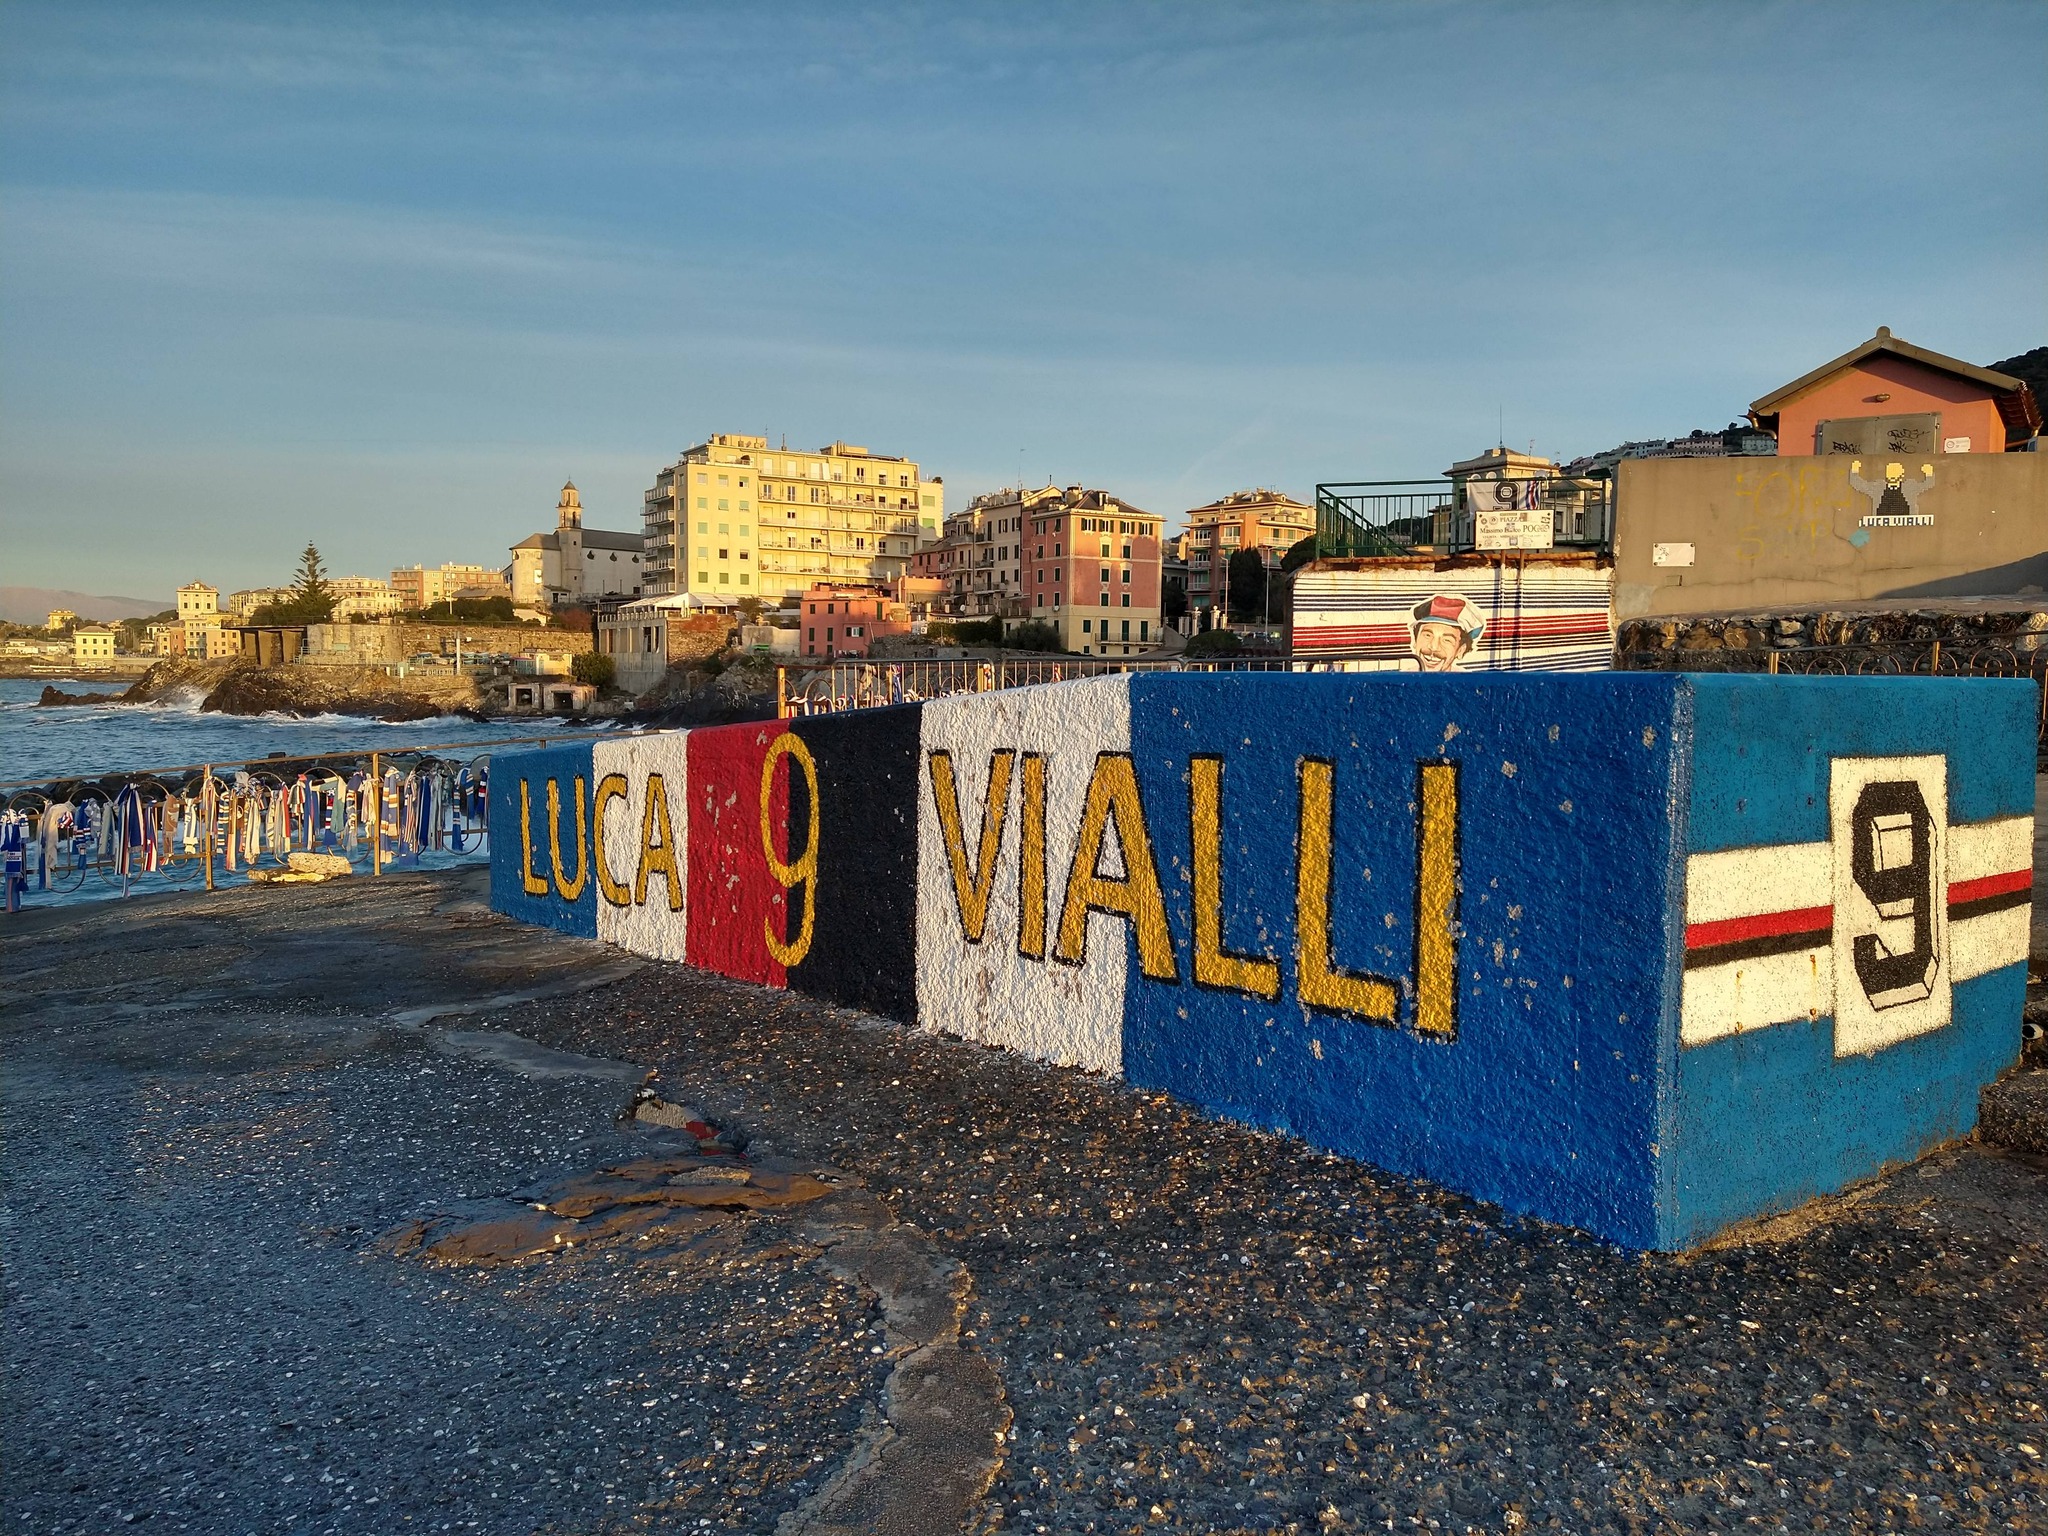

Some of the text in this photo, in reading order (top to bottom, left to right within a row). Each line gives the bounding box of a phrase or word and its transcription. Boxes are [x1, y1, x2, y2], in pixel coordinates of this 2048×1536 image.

[1894, 516, 1932, 526] VIALLI
[518, 732, 1463, 1045] LUCA 9 VIALLI
[1852, 780, 1940, 1011] 9
